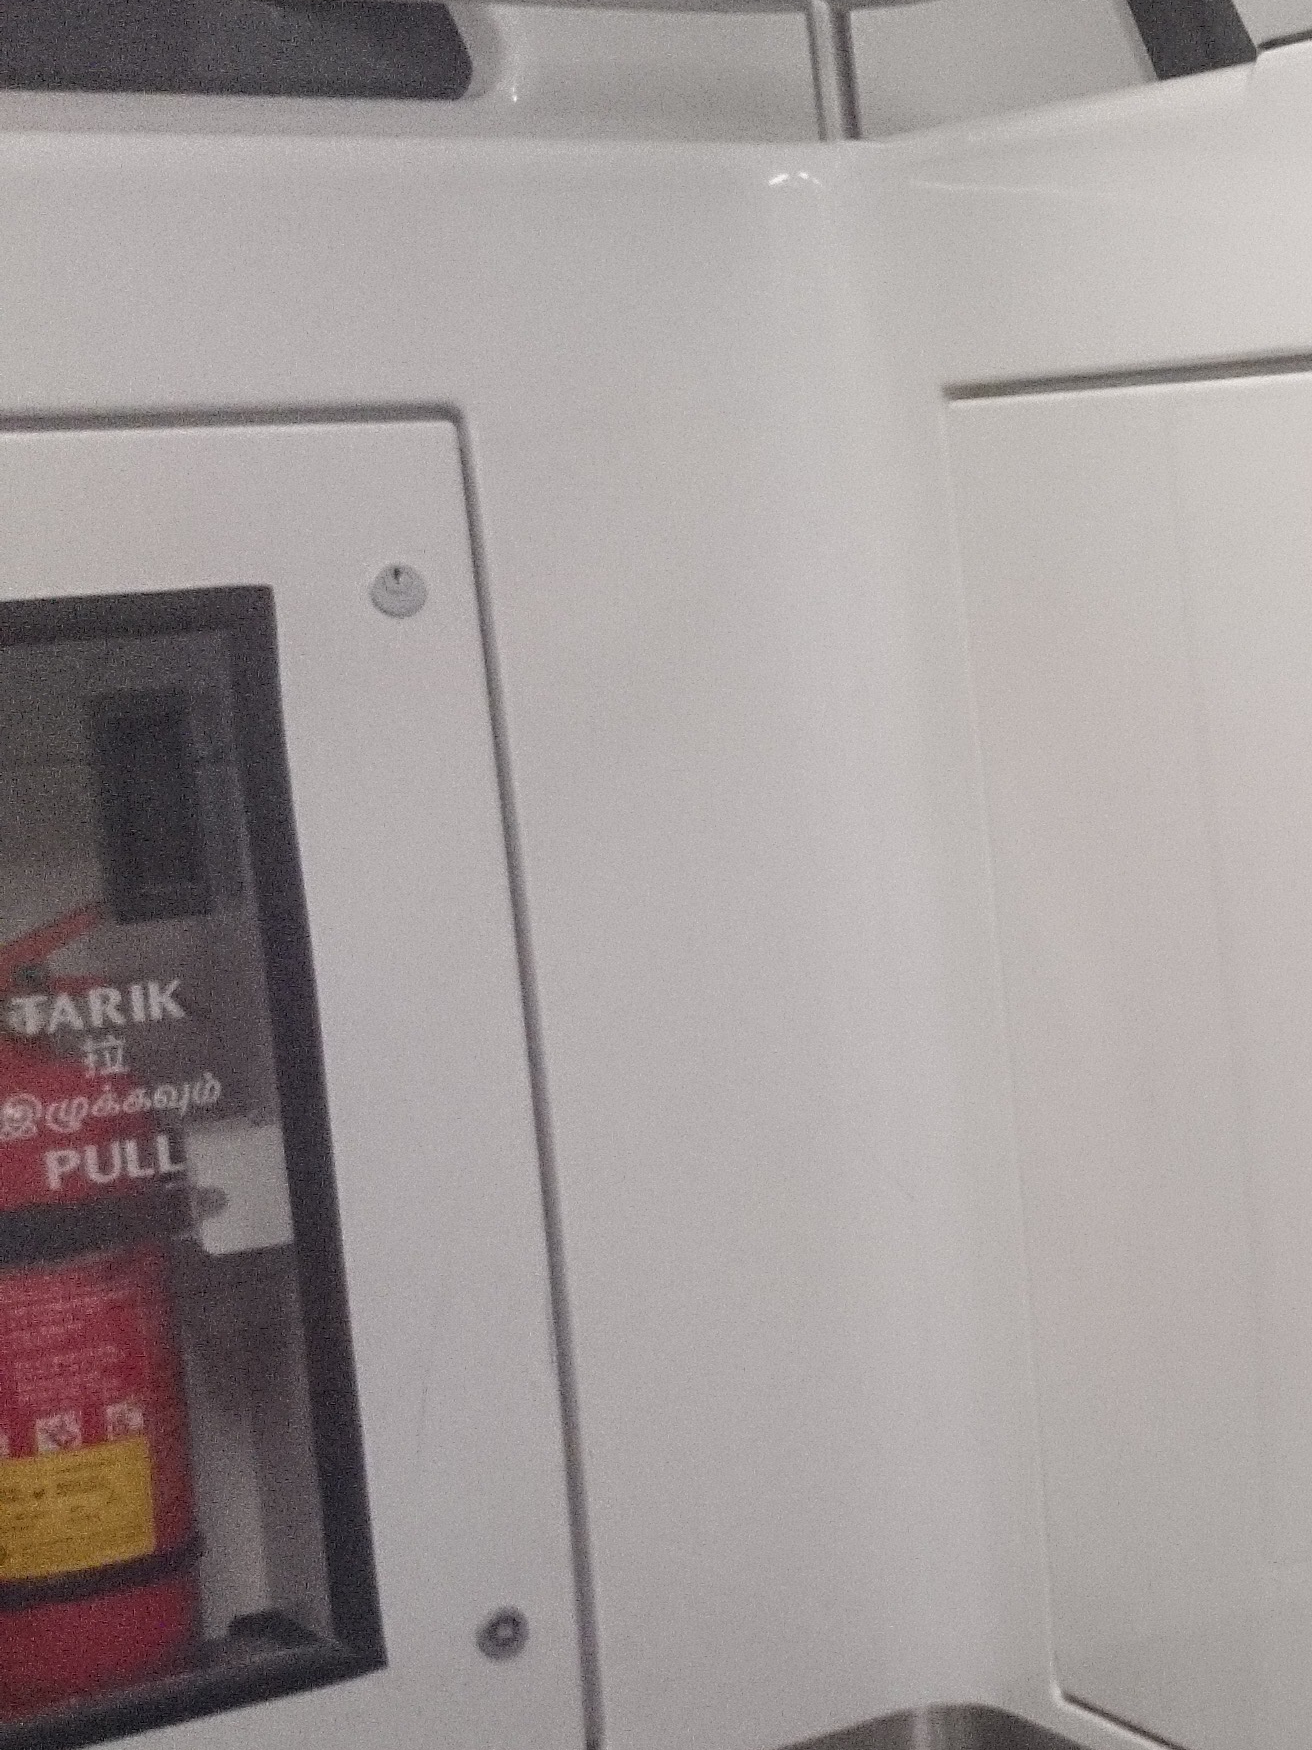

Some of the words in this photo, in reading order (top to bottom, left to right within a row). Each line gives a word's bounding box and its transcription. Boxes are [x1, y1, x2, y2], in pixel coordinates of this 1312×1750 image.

[9, 979, 187, 1035] TARIK
[83, 1034, 129, 1078] 拉
[45, 1134, 186, 1190] PULL
